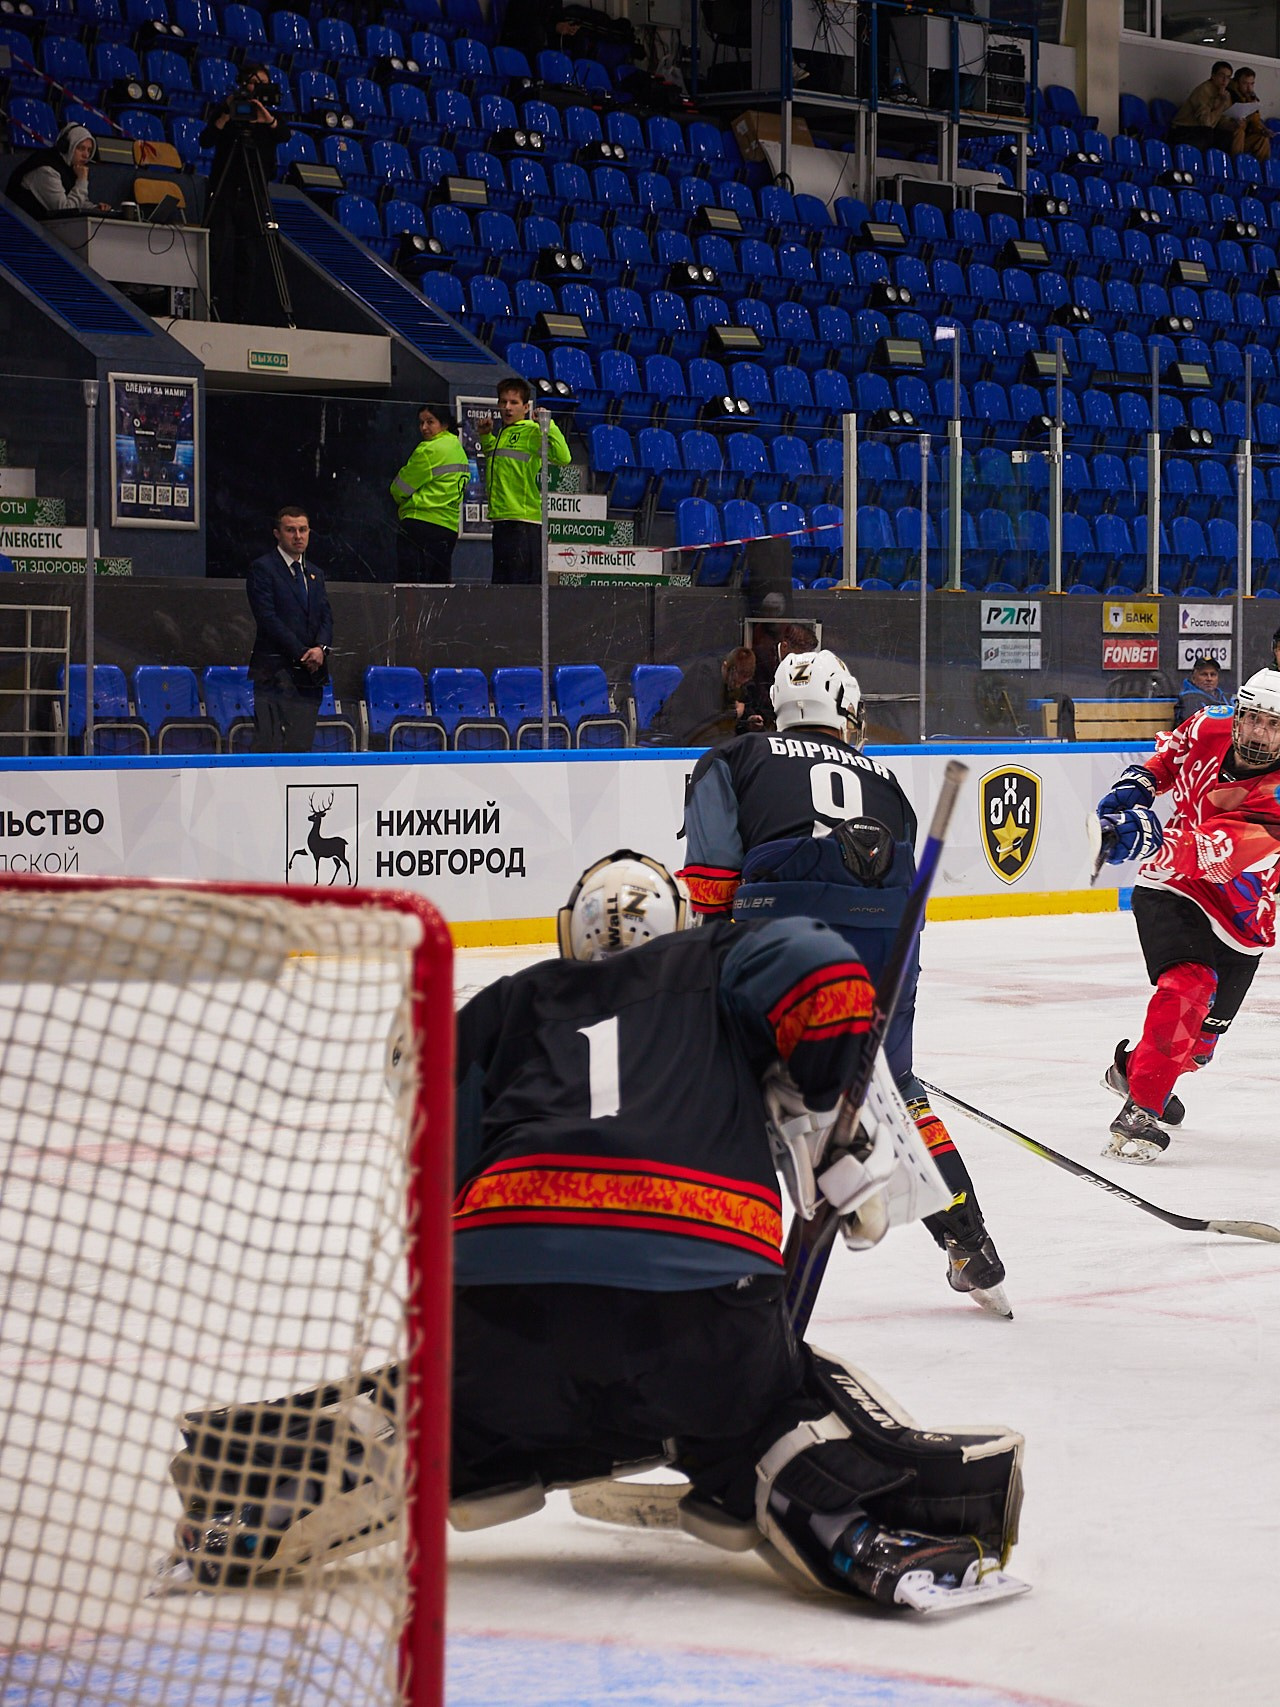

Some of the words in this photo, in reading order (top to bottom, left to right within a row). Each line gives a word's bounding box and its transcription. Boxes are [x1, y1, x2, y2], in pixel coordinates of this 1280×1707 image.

[251, 354, 287, 366] ВЫХОД
[125, 382, 152, 395] СЛЕДУЙ
[153, 386, 163, 395] ЗА
[164, 387, 187, 398] НАМИ!
[562, 524, 606, 537] КРАСОТЫ
[580, 551, 636, 567] SYNERGETIC
[986, 607, 1037, 625] PARI
[1125, 612, 1154, 624] БАНК
[1190, 618, 1230, 628] Ростелеком
[1104, 646, 1158, 663] FONBET
[810, 763, 863, 838] 9
[377, 800, 500, 837] НИЖНИЙ
[377, 847, 526, 878] НОВГОРОД
[576, 1015, 620, 1119] 1
